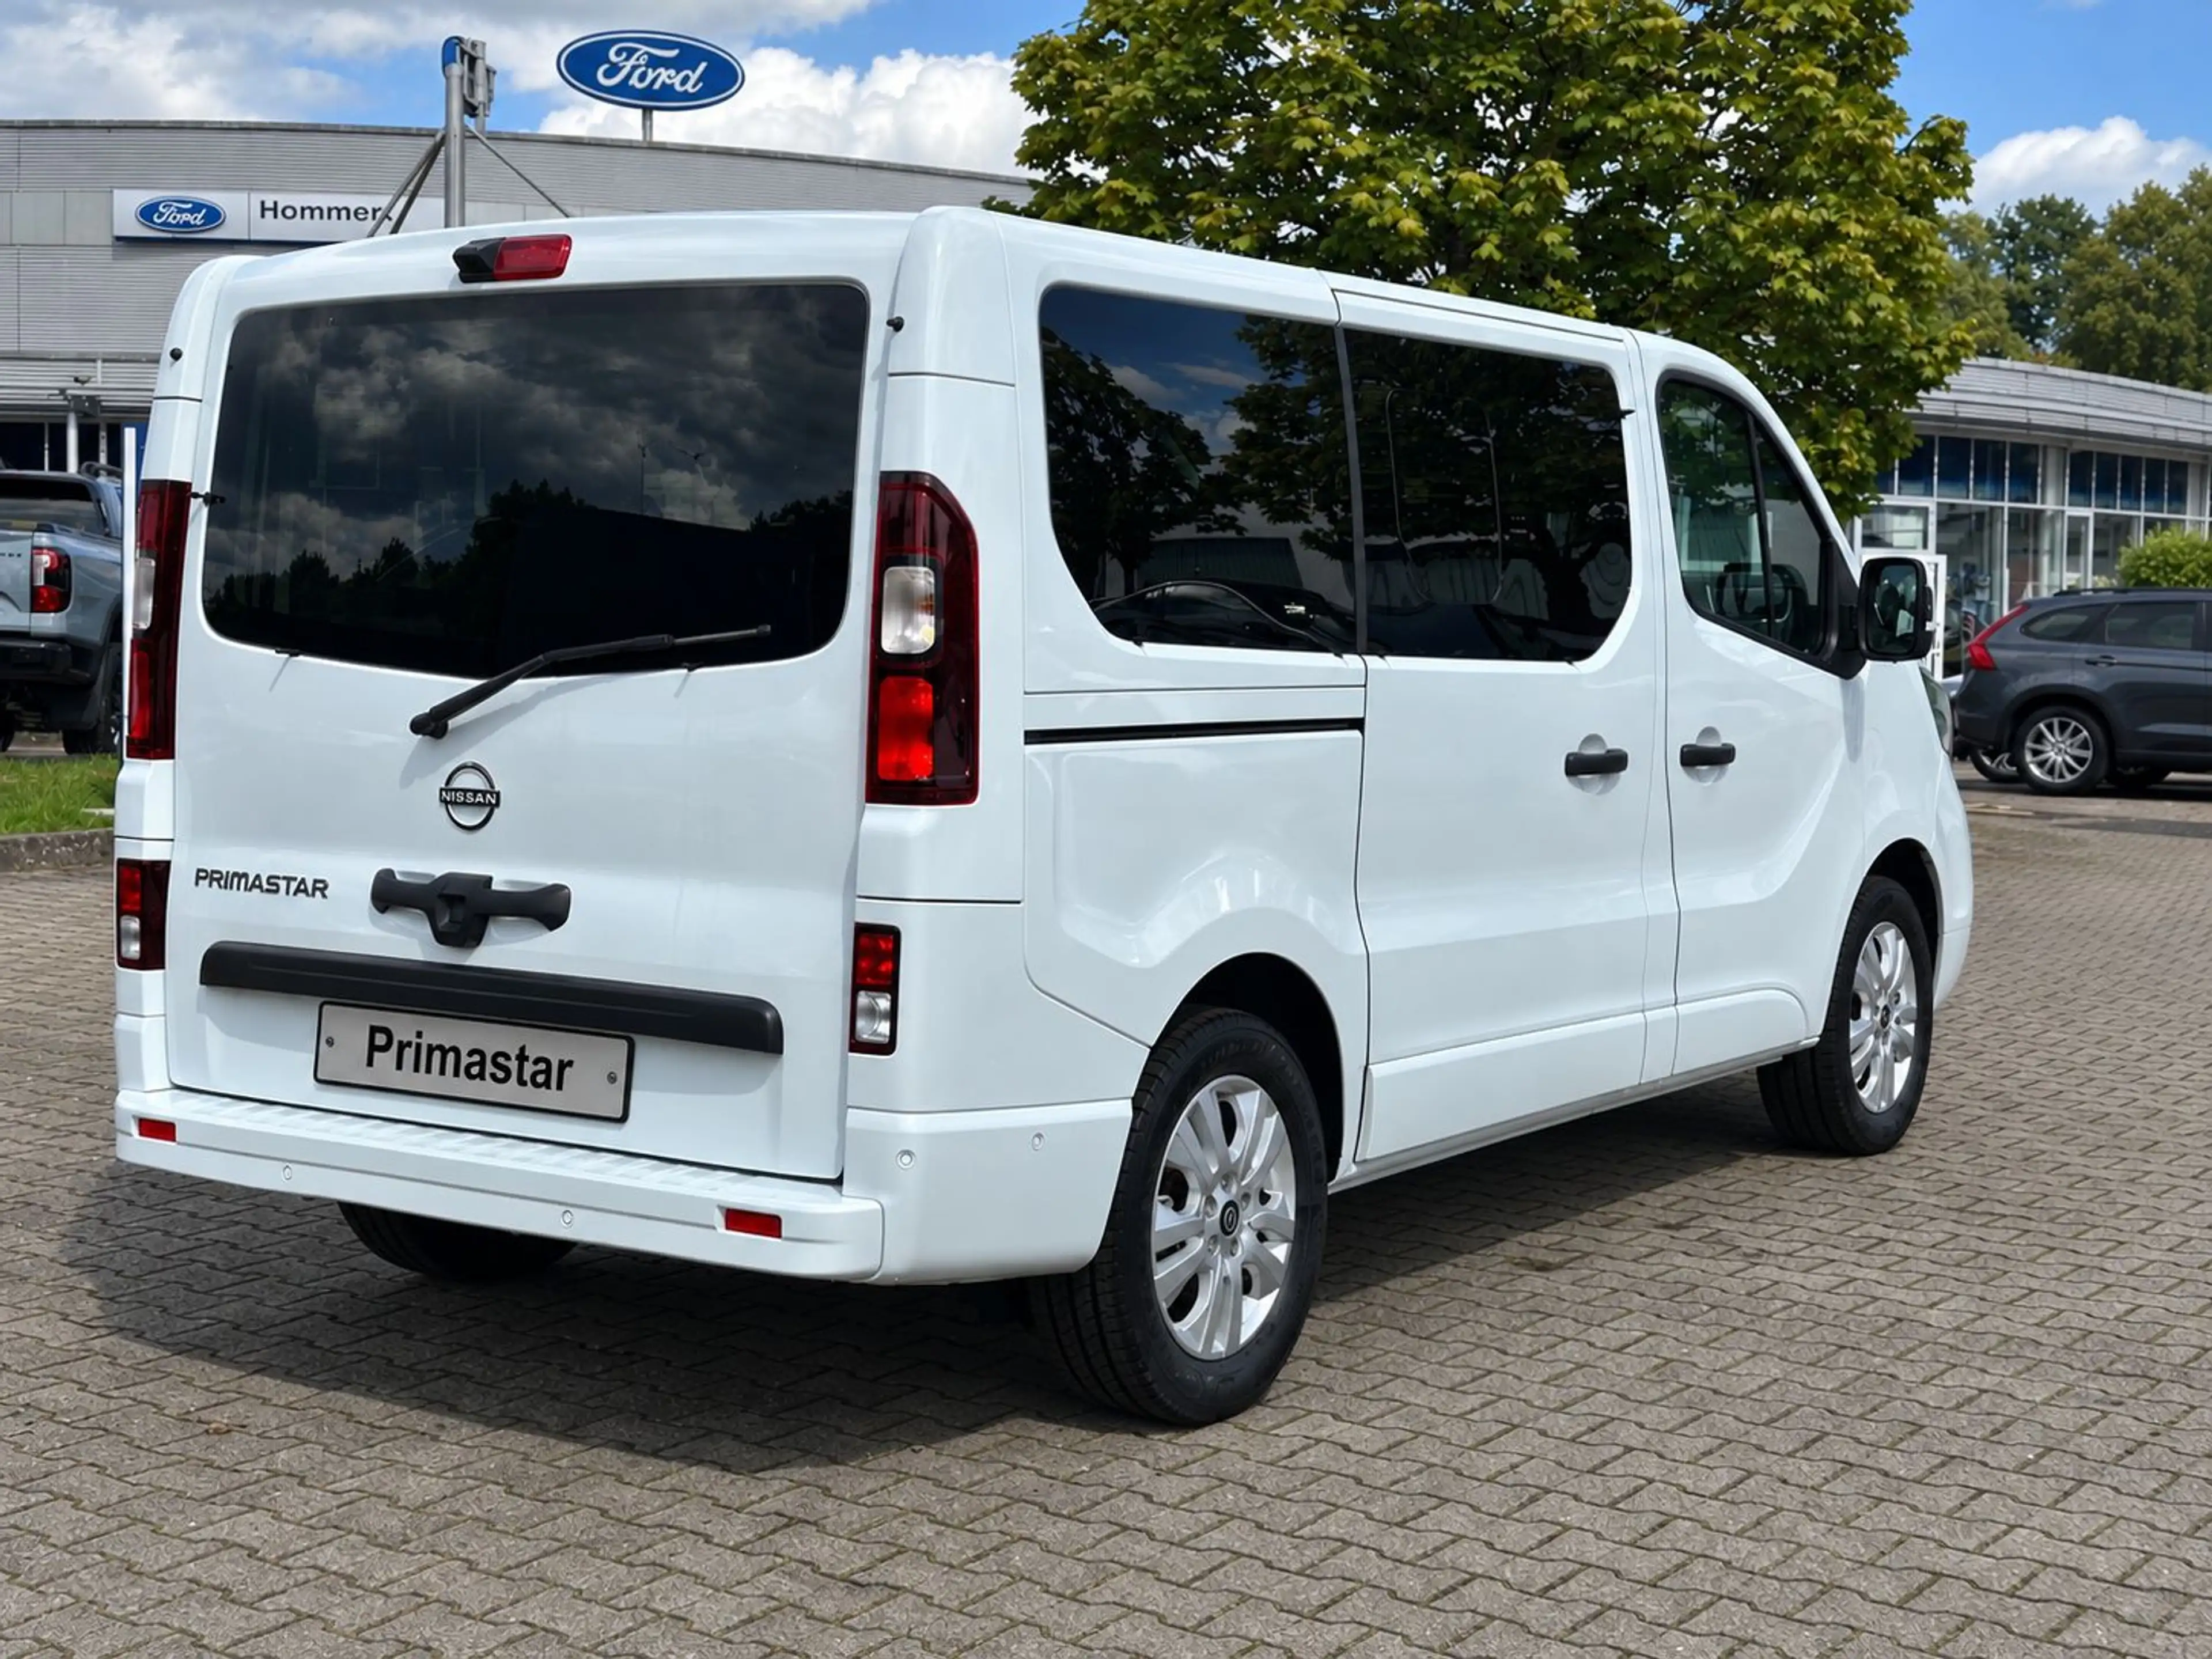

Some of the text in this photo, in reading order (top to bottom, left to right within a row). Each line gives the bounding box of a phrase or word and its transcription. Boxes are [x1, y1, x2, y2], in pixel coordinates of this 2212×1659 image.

[596, 41, 708, 93] Ford
[153, 201, 207, 226] Ford
[441, 790, 497, 805] NISSAN
[194, 867, 329, 899] PRIMASTAR
[366, 1024, 574, 1092] Primastar
